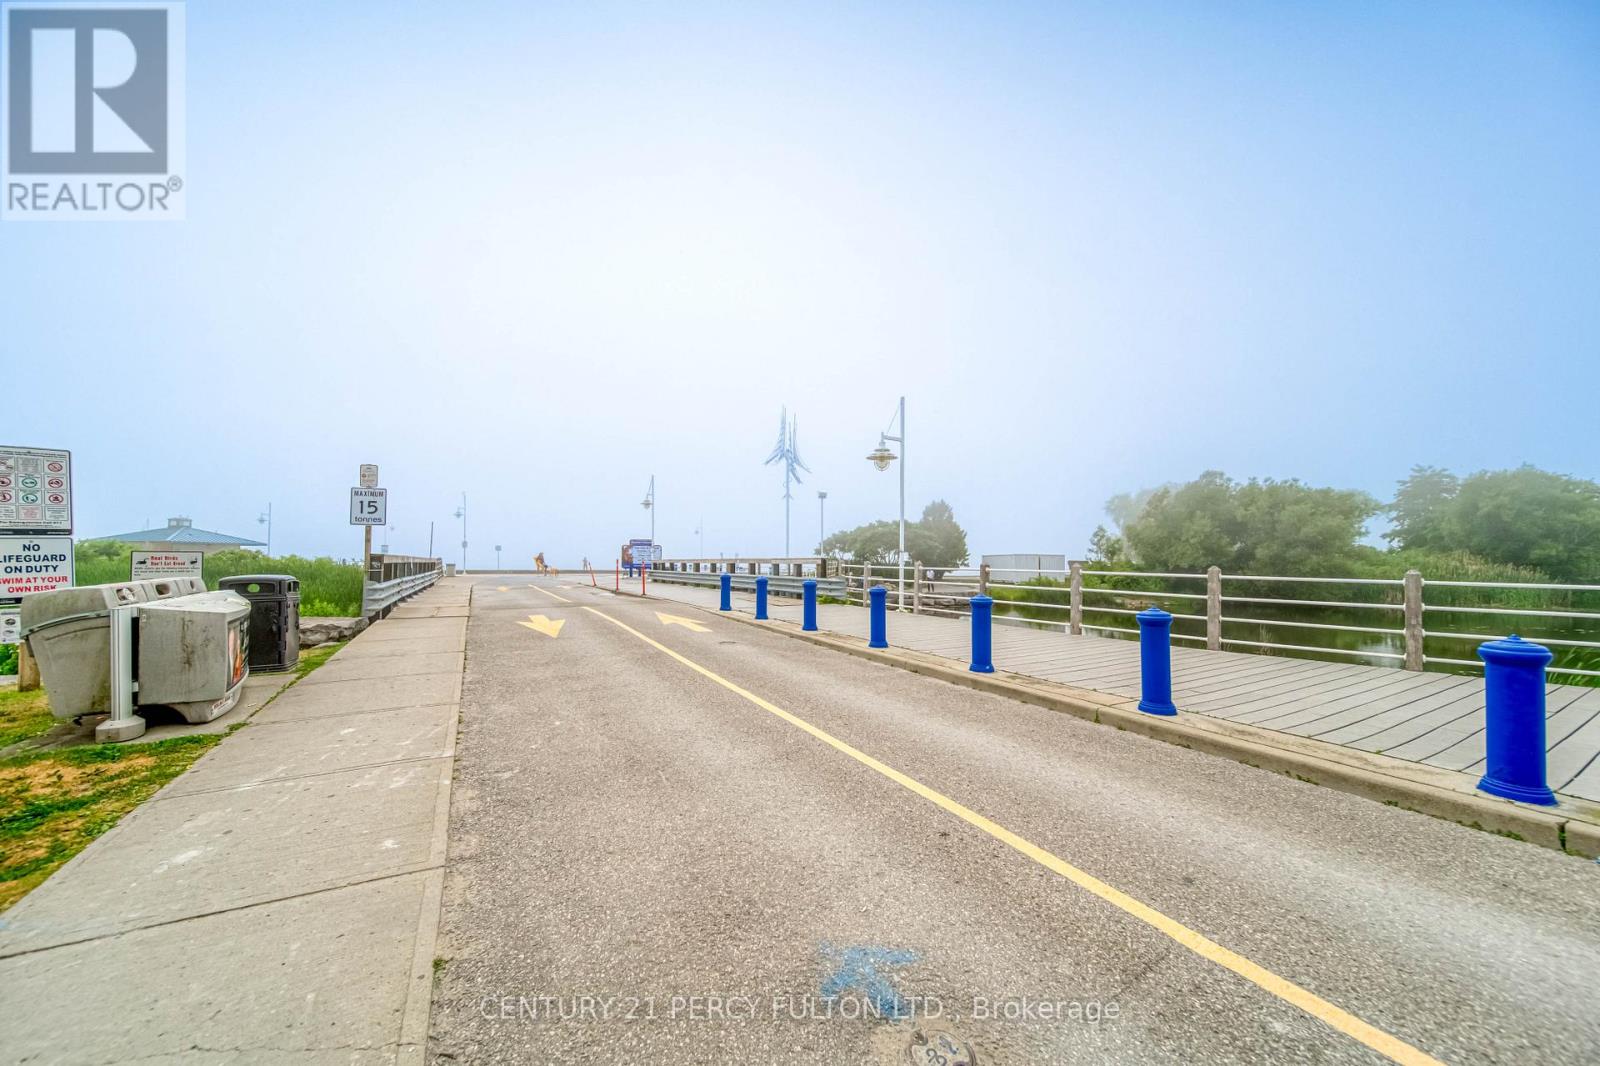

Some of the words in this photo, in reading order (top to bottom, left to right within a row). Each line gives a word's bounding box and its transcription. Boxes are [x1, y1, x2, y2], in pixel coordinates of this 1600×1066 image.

[359, 500, 378, 514] 15
[22, 543, 41, 552] NO
[4, 565, 22, 574] ON
[25, 565, 59, 573] DUTY
[0, 577, 23, 585] WIM
[25, 576, 38, 584] AT
[40, 575, 68, 583] YOUR
[8, 585, 31, 593] OWN
